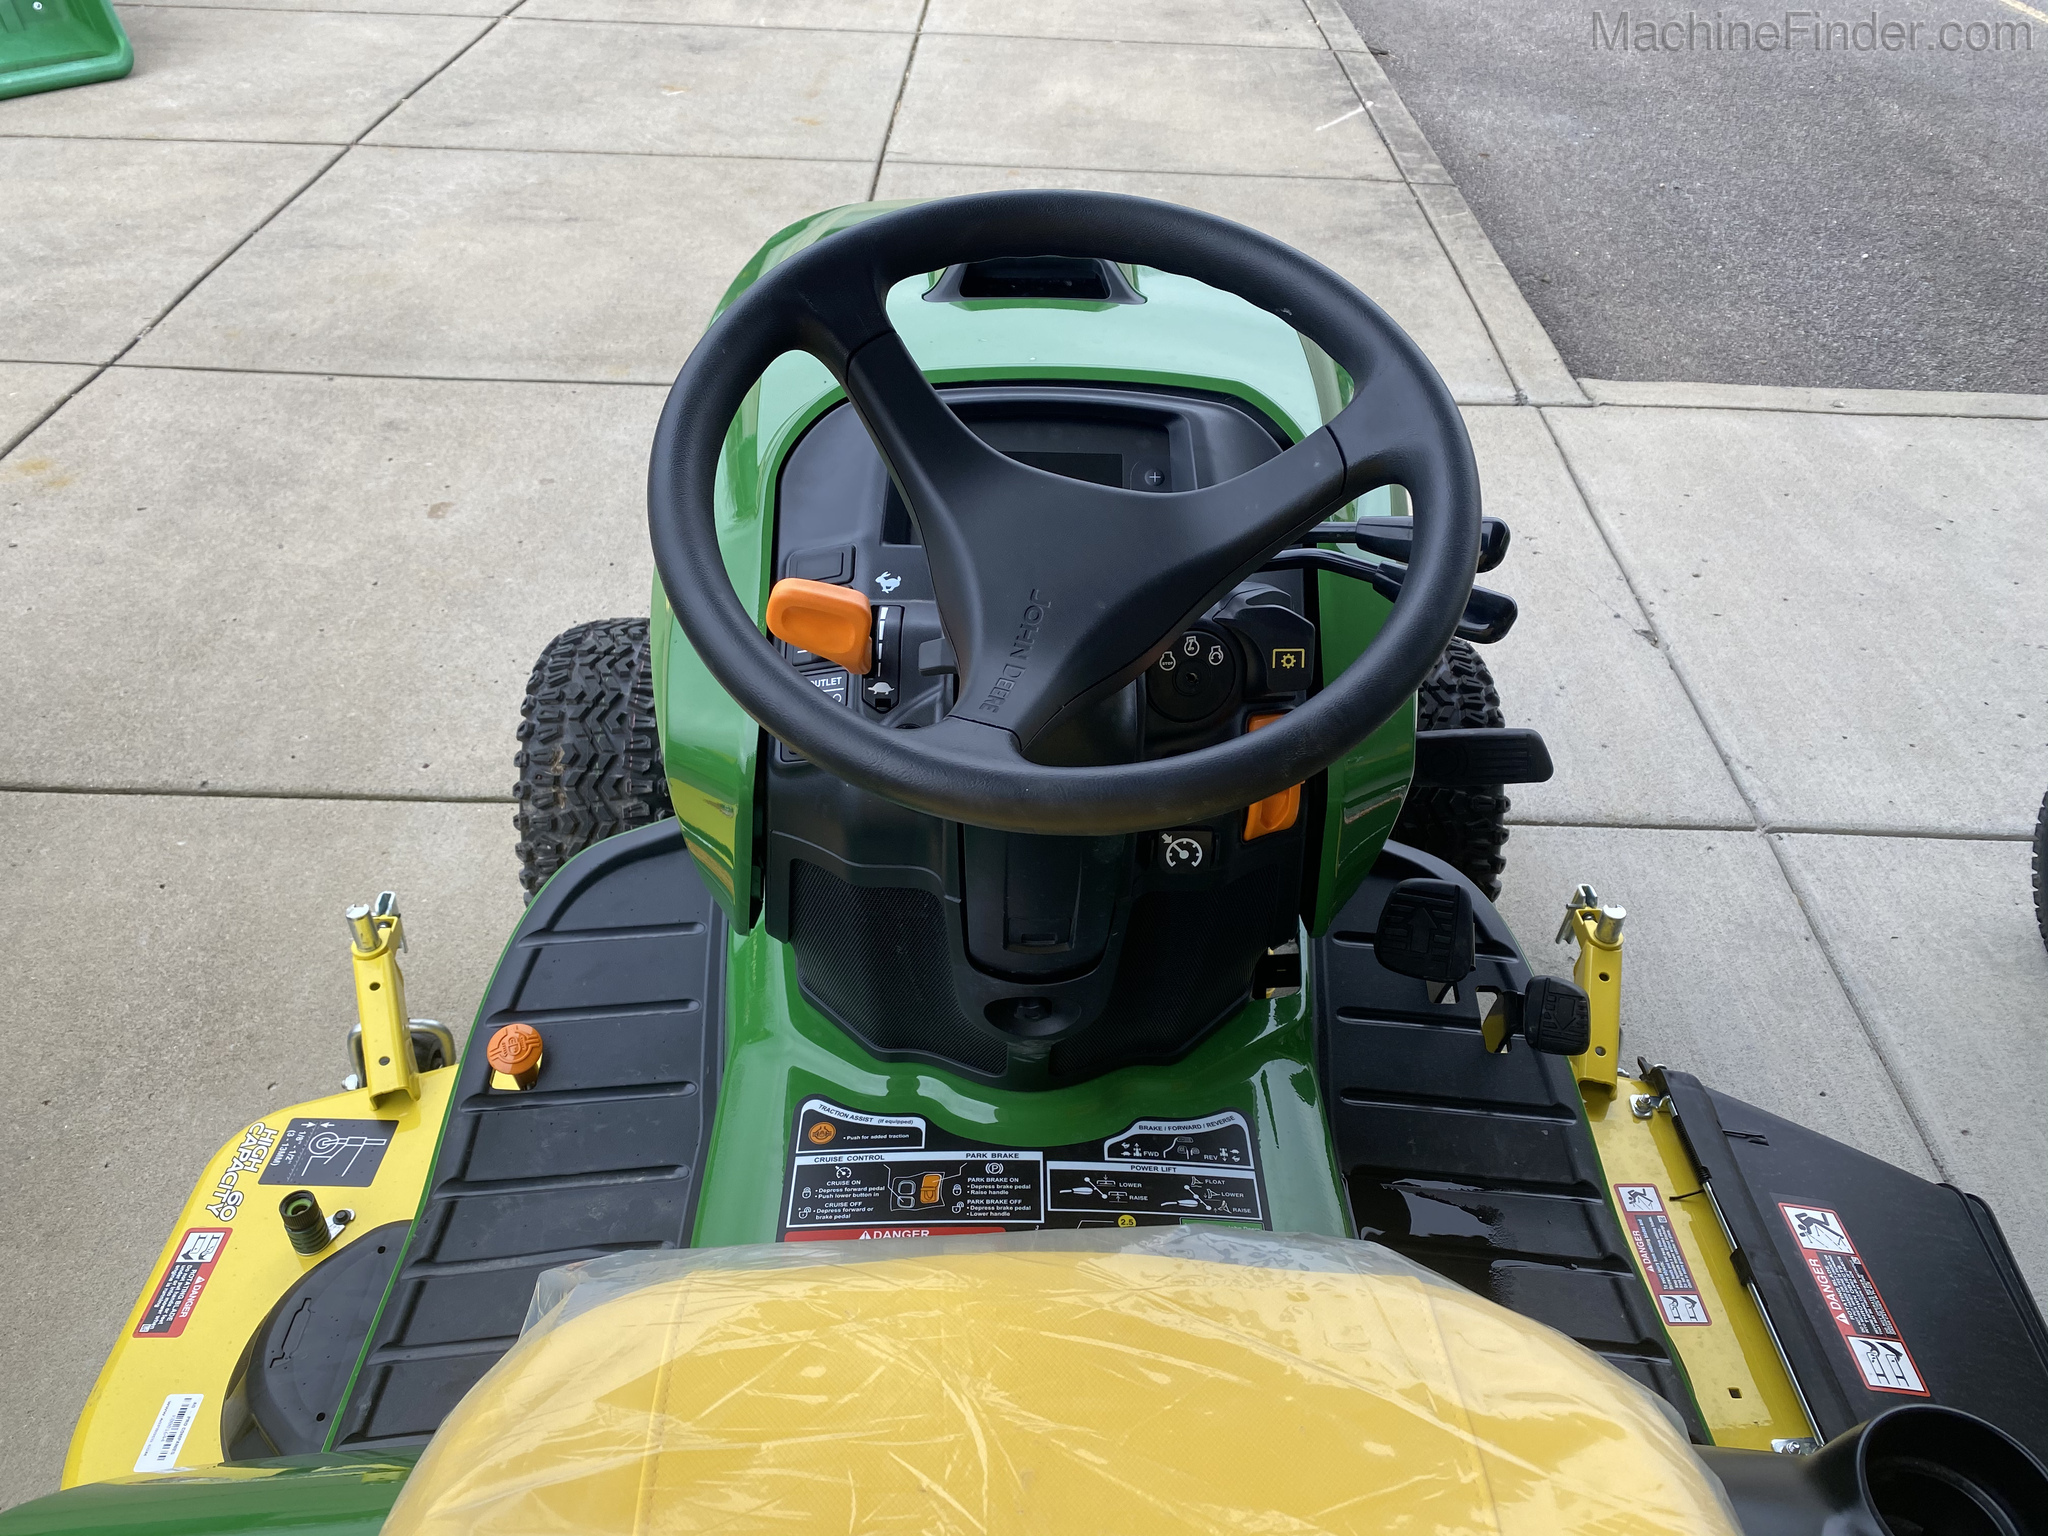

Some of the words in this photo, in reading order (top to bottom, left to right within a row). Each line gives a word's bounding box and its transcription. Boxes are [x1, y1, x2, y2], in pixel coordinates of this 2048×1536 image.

[1010, 588, 1051, 660] JOHN
[978, 663, 1027, 713] DEERE
[818, 1104, 849, 1119] TRACTION
[850, 1114, 874, 1123] ASSIST
[1168, 1124, 1202, 1132] FORWARD
[1206, 1115, 1236, 1128] REVERSE
[243, 1126, 280, 1173] HIGH
[206, 1122, 266, 1218] CAPACITY
[219, 1190, 244, 1222] 60
[873, 1230, 930, 1239] DANGER
[1632, 1230, 1651, 1264] DANGER
[177, 1270, 197, 1299] ROTATING
[1808, 1258, 1842, 1310] DANGER
[1824, 1265, 1838, 1286] BLADE
[1837, 1265, 1855, 1294] OBJECTS
[166, 1301, 182, 1321] BLADE
[179, 1285, 202, 1317] DANGER
[1835, 1288, 1855, 1320] ROTATING
[1852, 1295, 1870, 1323] THROWN
